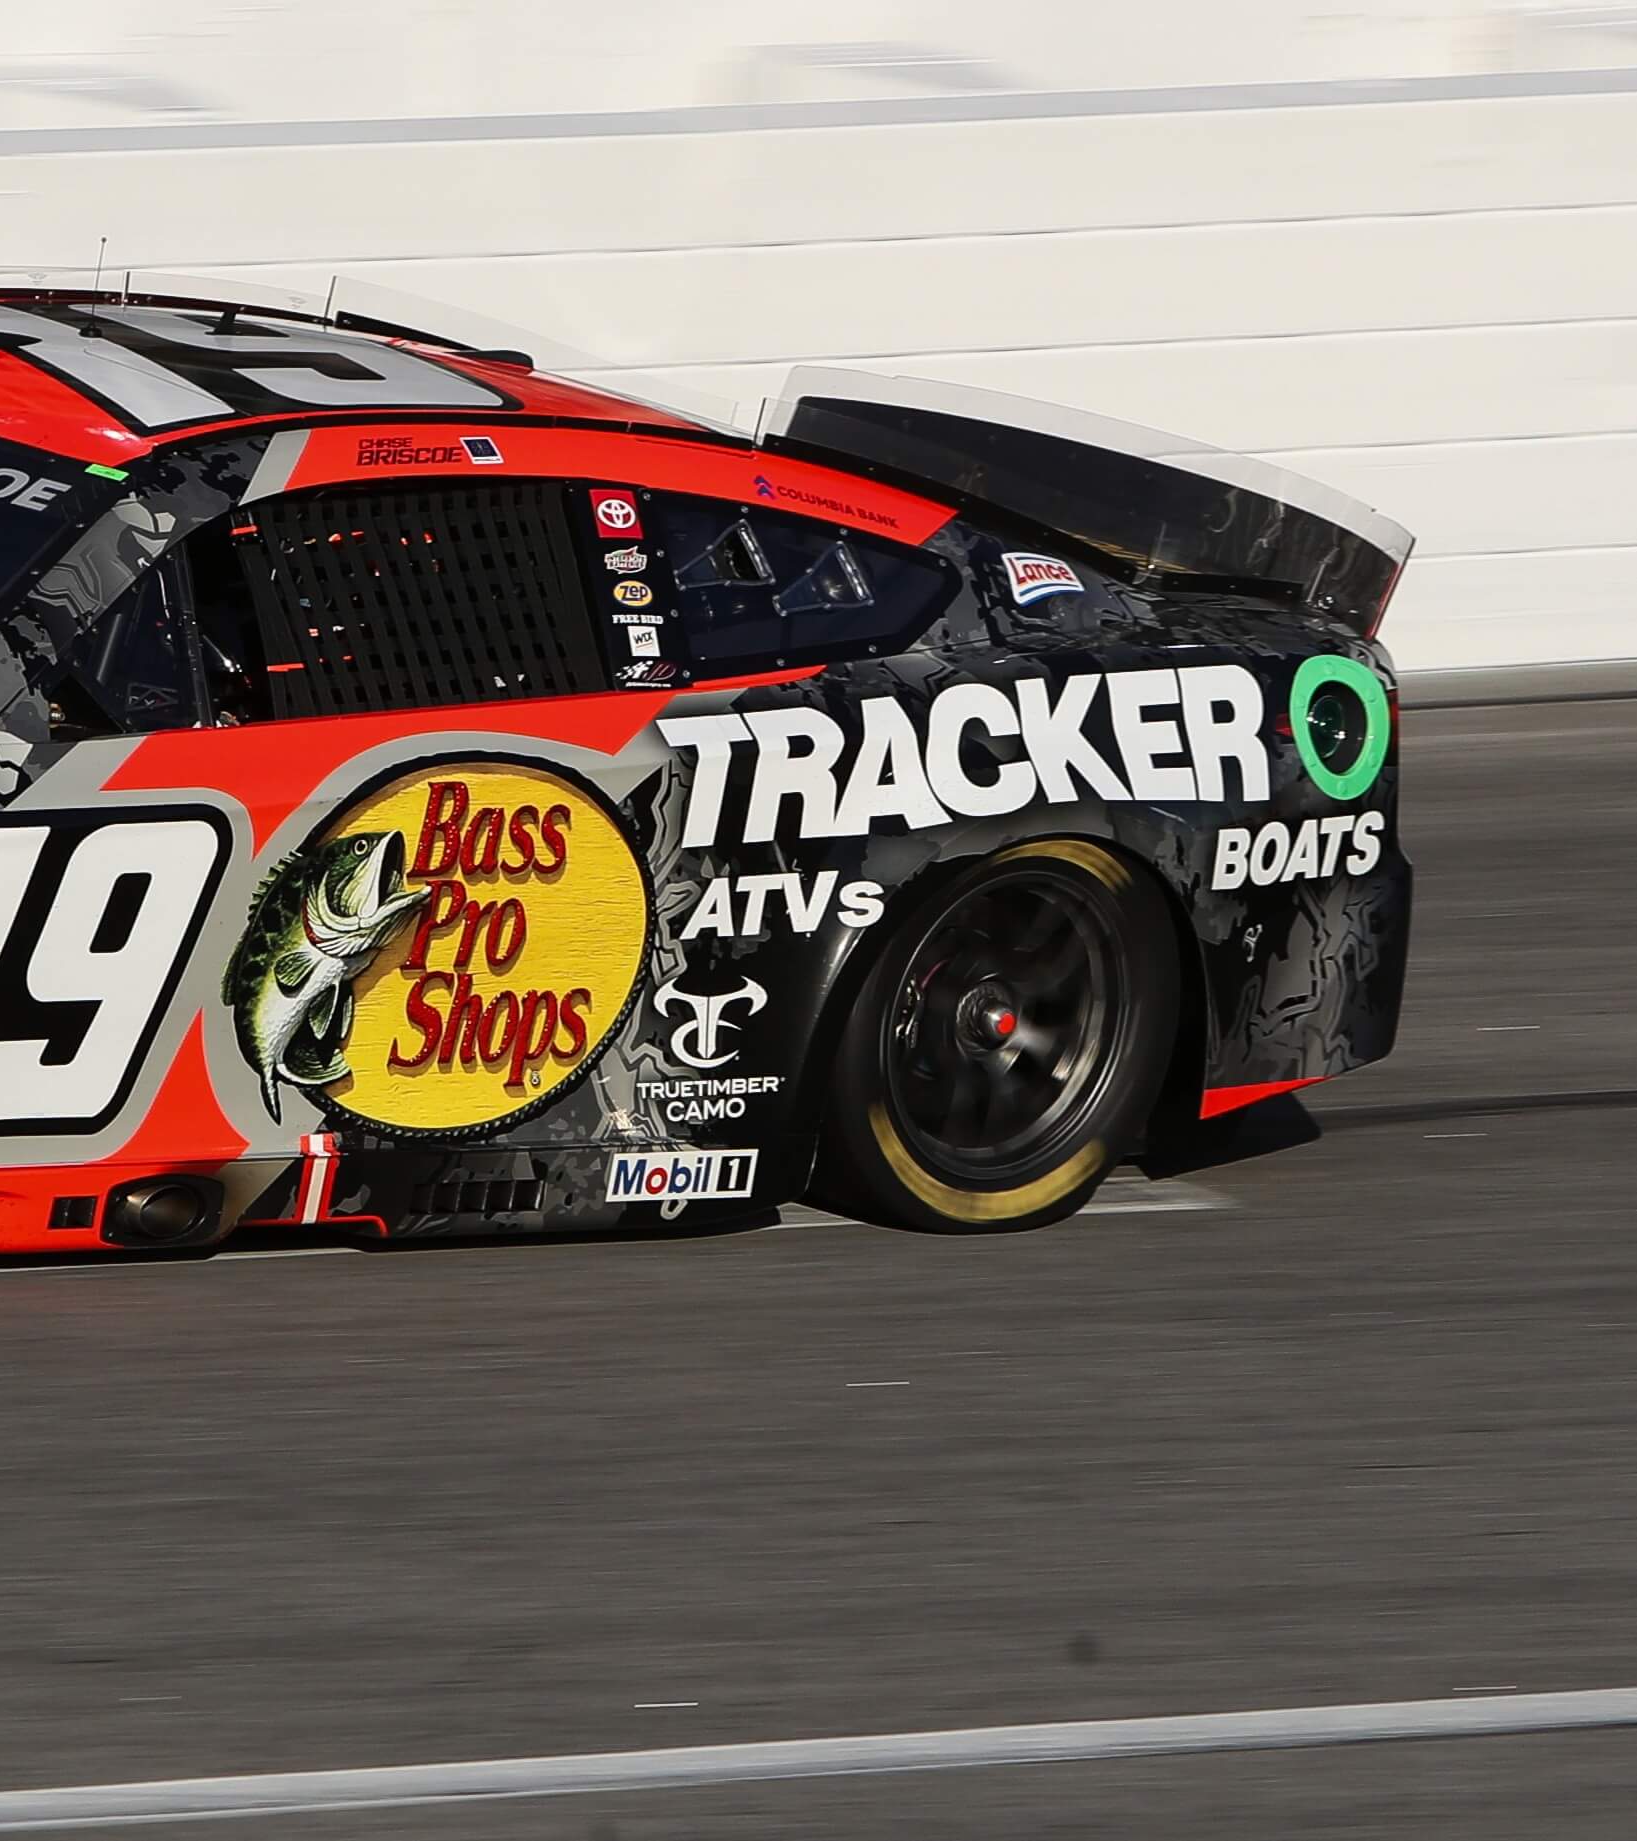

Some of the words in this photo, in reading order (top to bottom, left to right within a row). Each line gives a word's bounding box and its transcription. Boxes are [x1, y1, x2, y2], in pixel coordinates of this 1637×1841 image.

[355, 446, 464, 466] BRISCOE
[359, 437, 413, 449] CHASE
[776, 485, 855, 518] COLUMBIA
[857, 507, 900, 529] BANK
[1007, 557, 1074, 586] Lance
[612, 613, 640, 625] FREE
[641, 615, 664, 625] BIRD
[633, 630, 654, 644] WIX
[657, 664, 1271, 848] TRACKER
[407, 780, 571, 878] Bass
[1211, 810, 1385, 891] BOATS
[681, 870, 885, 940] ATVs
[401, 880, 527, 972] Pro
[388, 971, 593, 1088] Shops
[636, 1076, 780, 1099] TRUETIMBER
[666, 1097, 746, 1123] CAMO
[612, 1155, 714, 1196] Mobil
